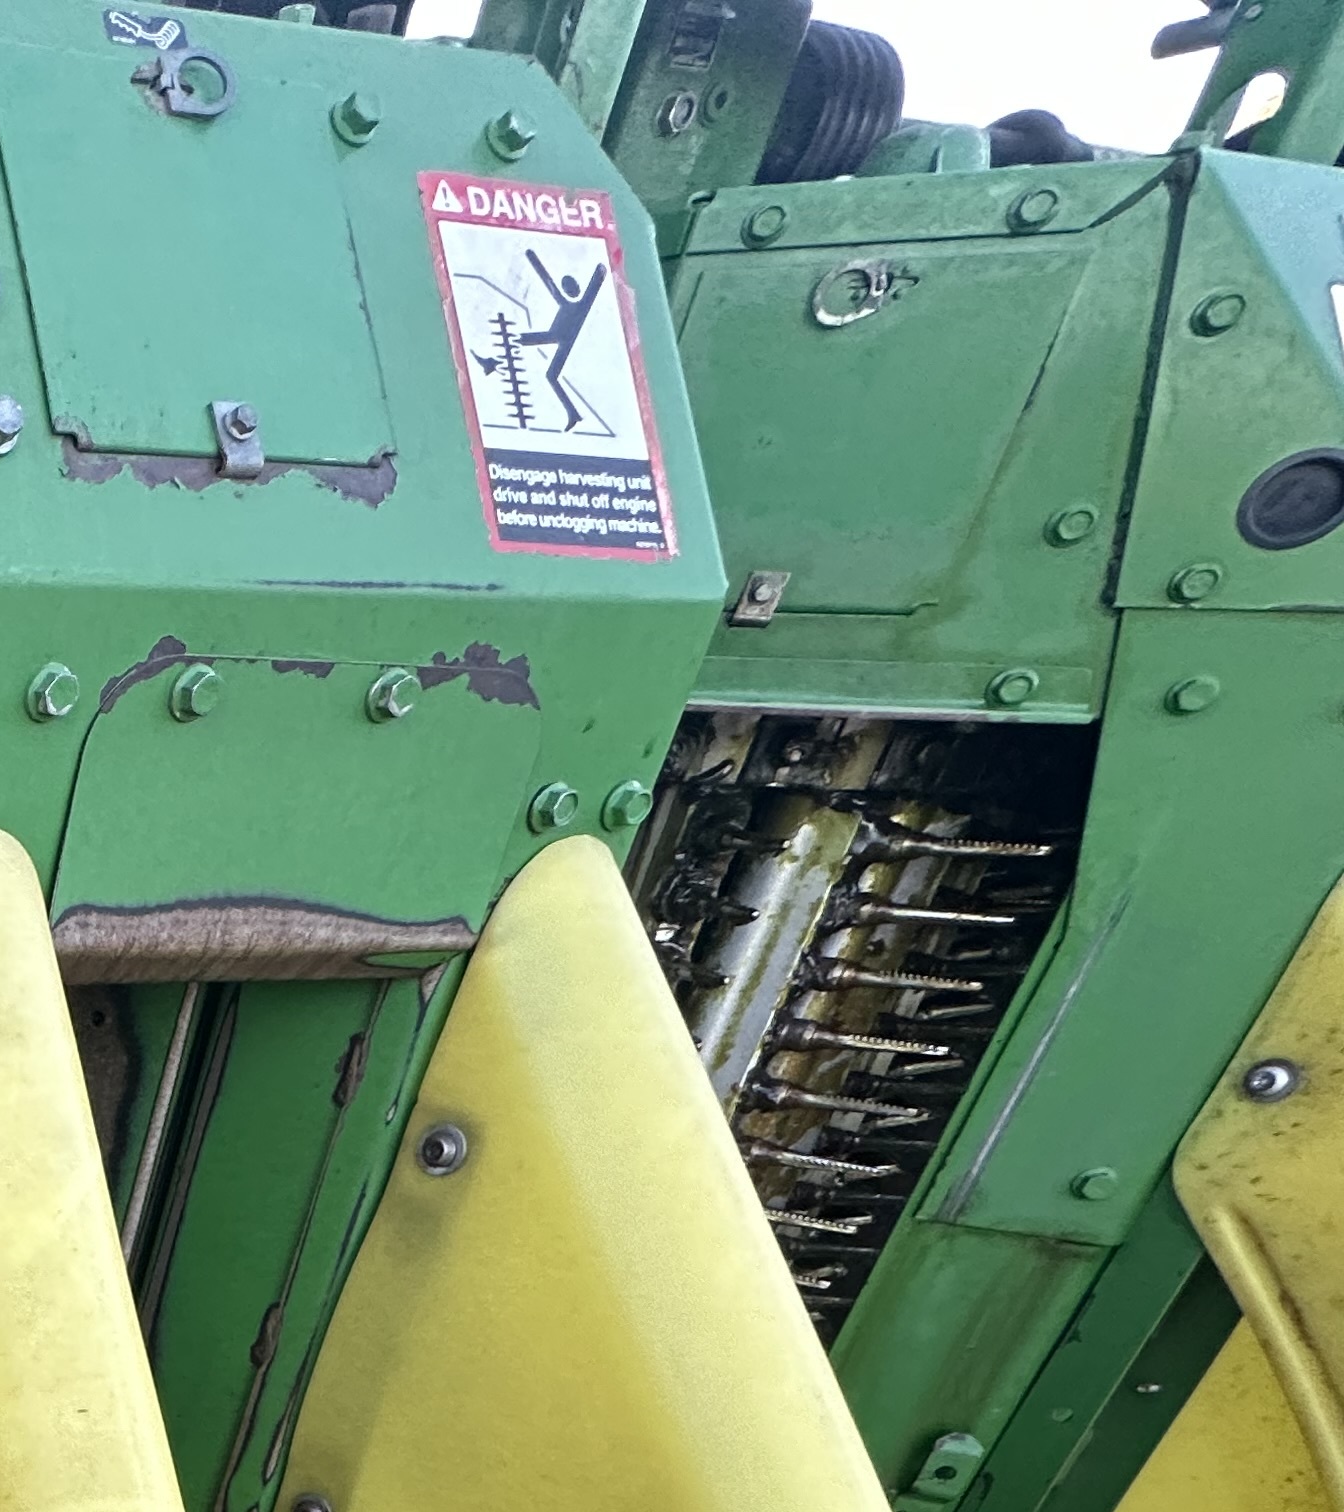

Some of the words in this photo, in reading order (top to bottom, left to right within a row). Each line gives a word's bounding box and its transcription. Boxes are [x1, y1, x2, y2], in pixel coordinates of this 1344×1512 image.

[466, 186, 604, 230] DANGER
[489, 463, 558, 487] Disengage
[558, 469, 626, 492] harvesting
[627, 475, 652, 490] unit
[493, 486, 528, 504] drive
[530, 490, 557, 505] and
[559, 491, 590, 508] shut
[591, 493, 610, 509] off
[612, 496, 657, 515] engine
[496, 508, 538, 527] before
[538, 513, 607, 534] unclogging
[608, 518, 662, 534] machine.
